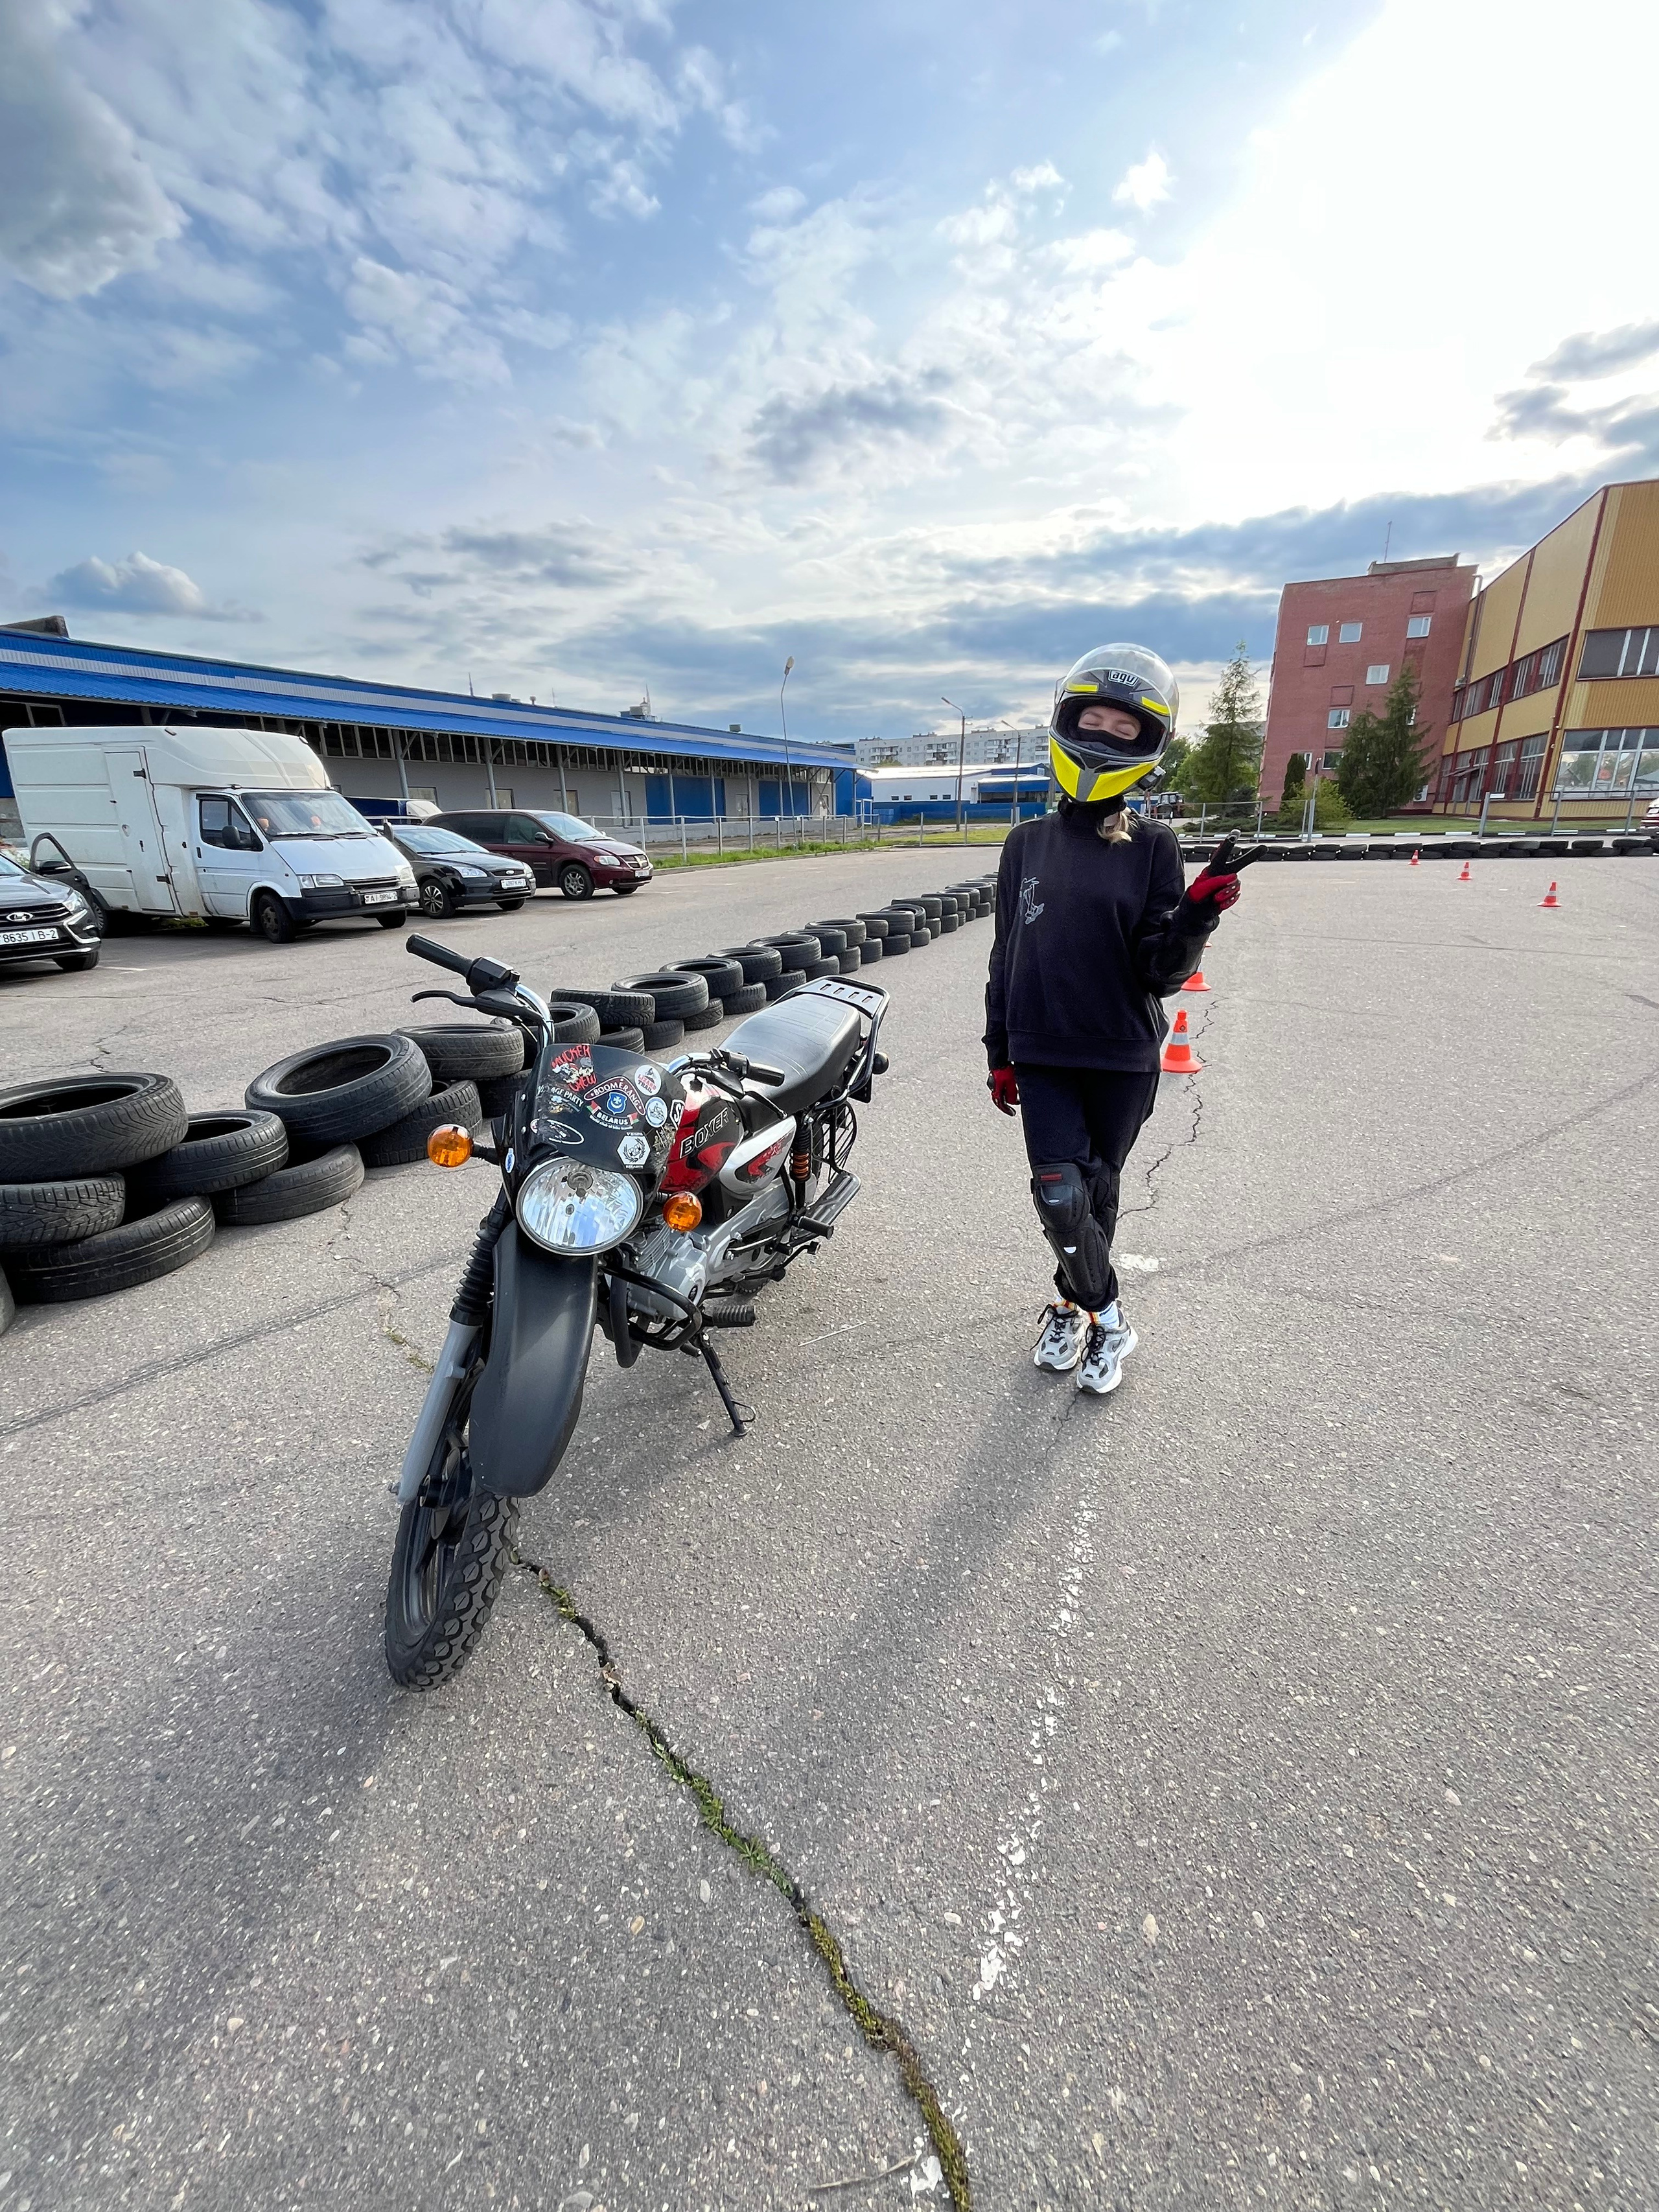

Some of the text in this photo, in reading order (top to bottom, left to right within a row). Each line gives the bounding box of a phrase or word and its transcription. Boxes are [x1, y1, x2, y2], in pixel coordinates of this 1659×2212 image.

[1112, 671, 1135, 682] agv
[3, 933, 29, 943] 8635
[637, 1074, 656, 1091] LIZARD
[638, 1080, 653, 1093] TRAIL
[563, 1090, 584, 1107] PARTY
[594, 1082, 640, 1106] BOOMERANG
[596, 1112, 629, 1125] BELARUS
[680, 1107, 729, 1159] BOXER
